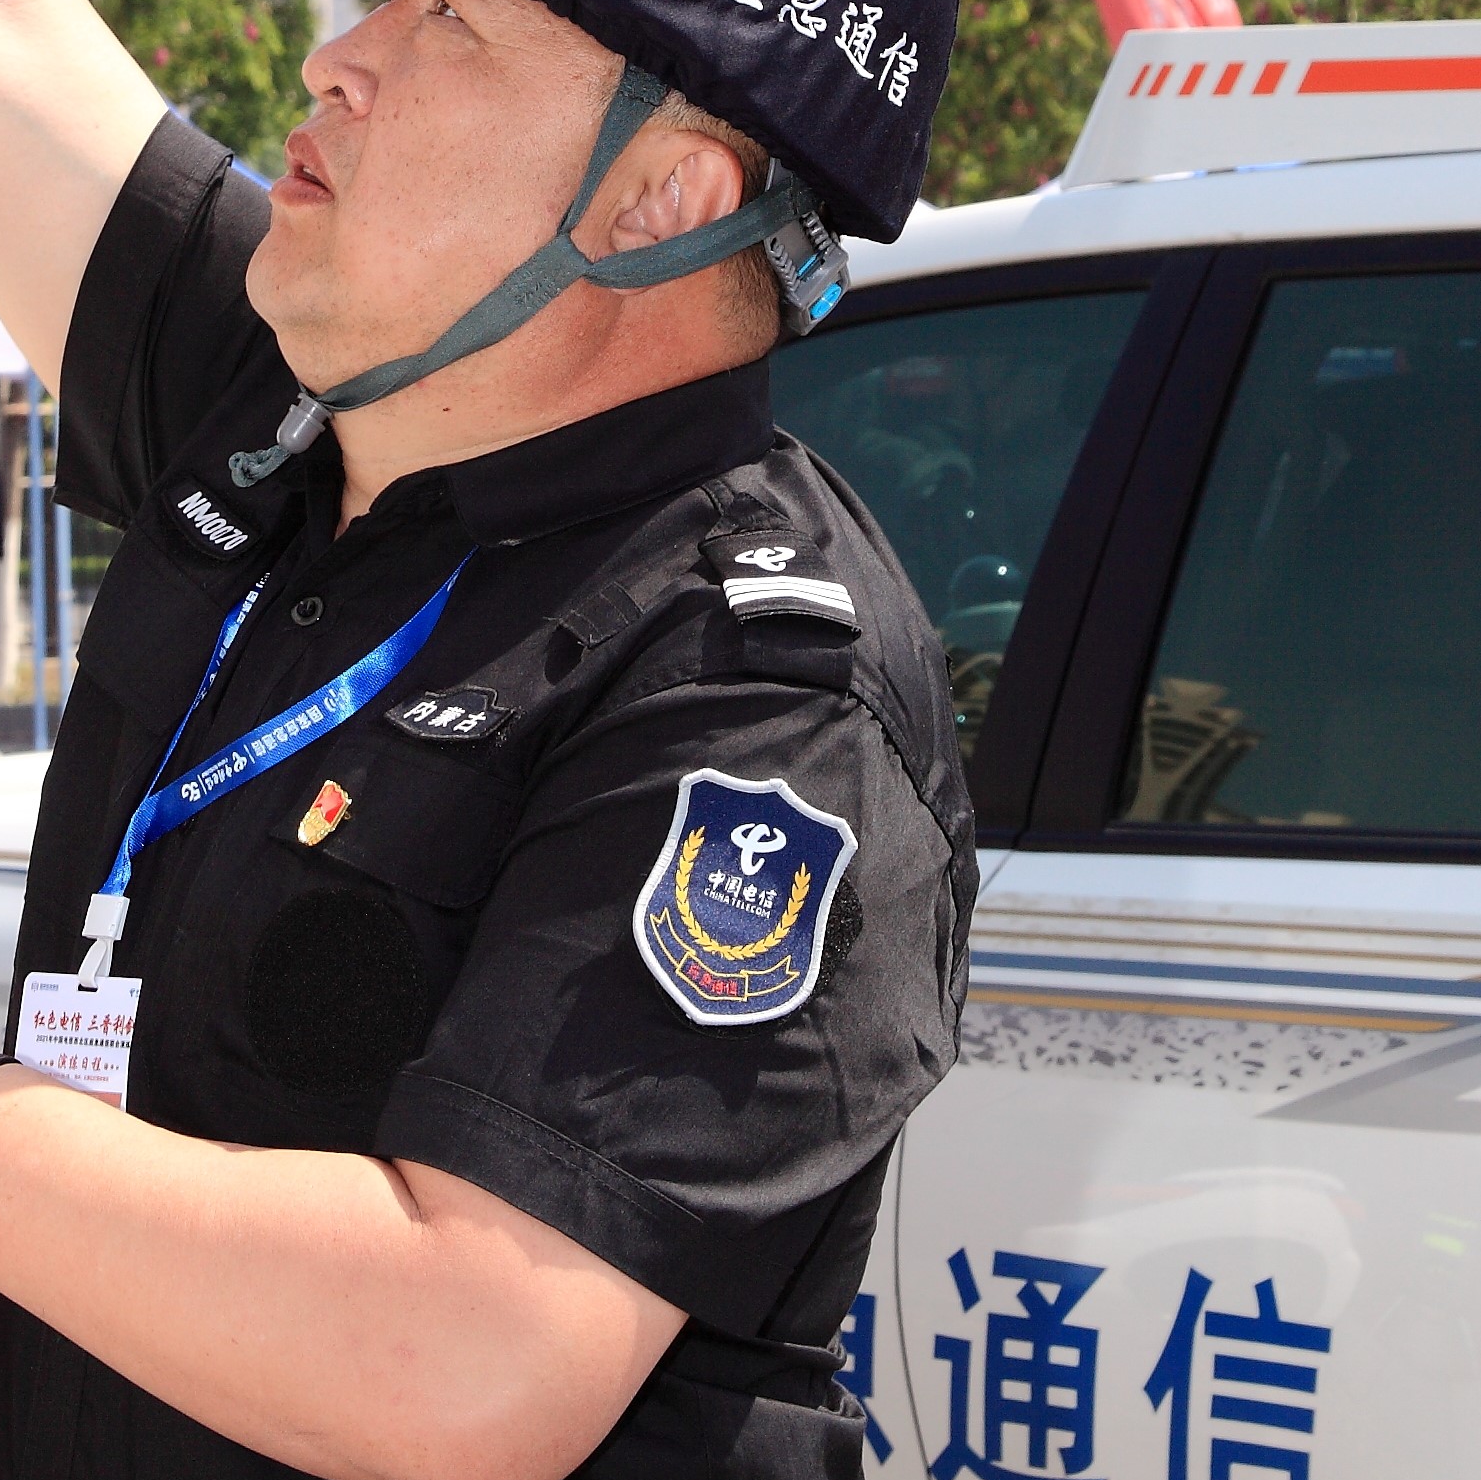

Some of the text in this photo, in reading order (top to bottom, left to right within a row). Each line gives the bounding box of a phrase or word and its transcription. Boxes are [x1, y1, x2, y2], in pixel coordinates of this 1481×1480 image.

[403, 700, 487, 733] 内蒙古
[704, 887, 771, 920] CHINA TELECOM
[708, 869, 778, 909] 中国电信
